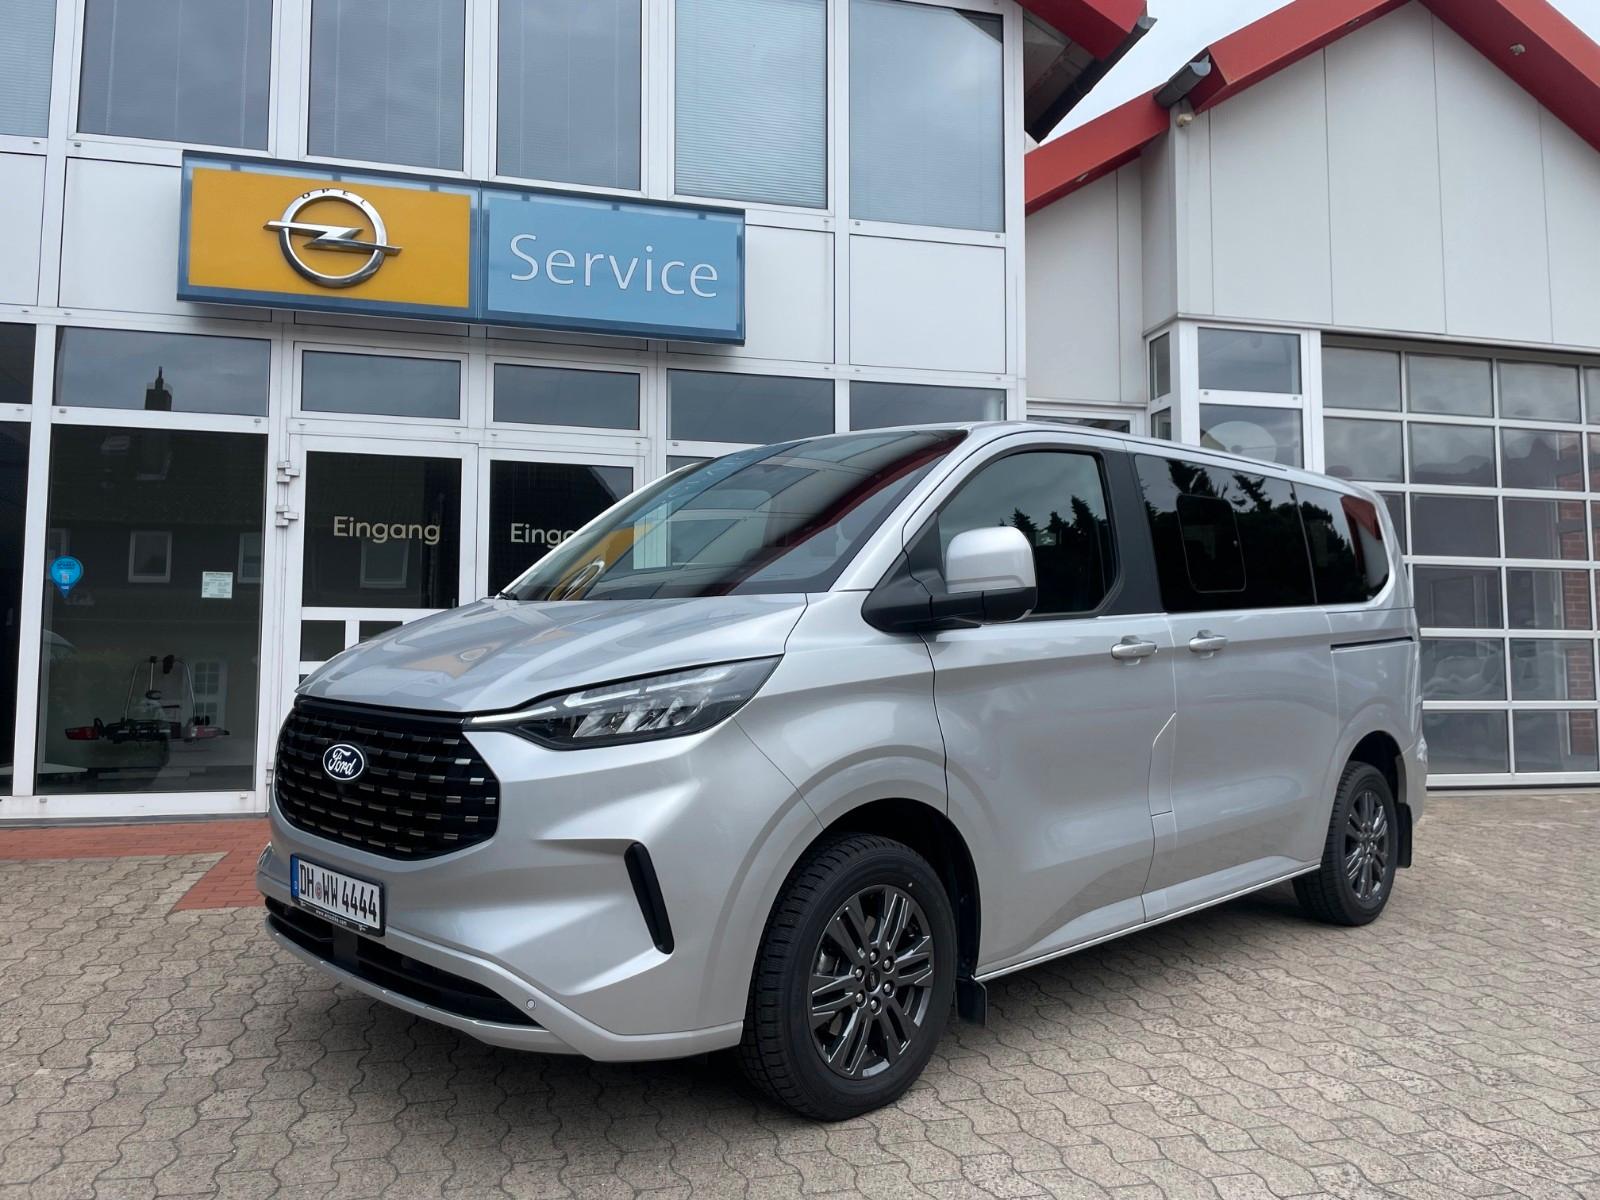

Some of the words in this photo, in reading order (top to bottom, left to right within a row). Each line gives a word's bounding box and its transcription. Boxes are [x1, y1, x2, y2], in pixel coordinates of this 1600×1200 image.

[302, 188, 366, 206] OPEL
[510, 233, 718, 298] Service
[333, 516, 441, 545] Eingang
[328, 748, 357, 775] Ford
[300, 864, 314, 899] DH
[322, 872, 338, 908] WW
[342, 881, 377, 922] 4444
